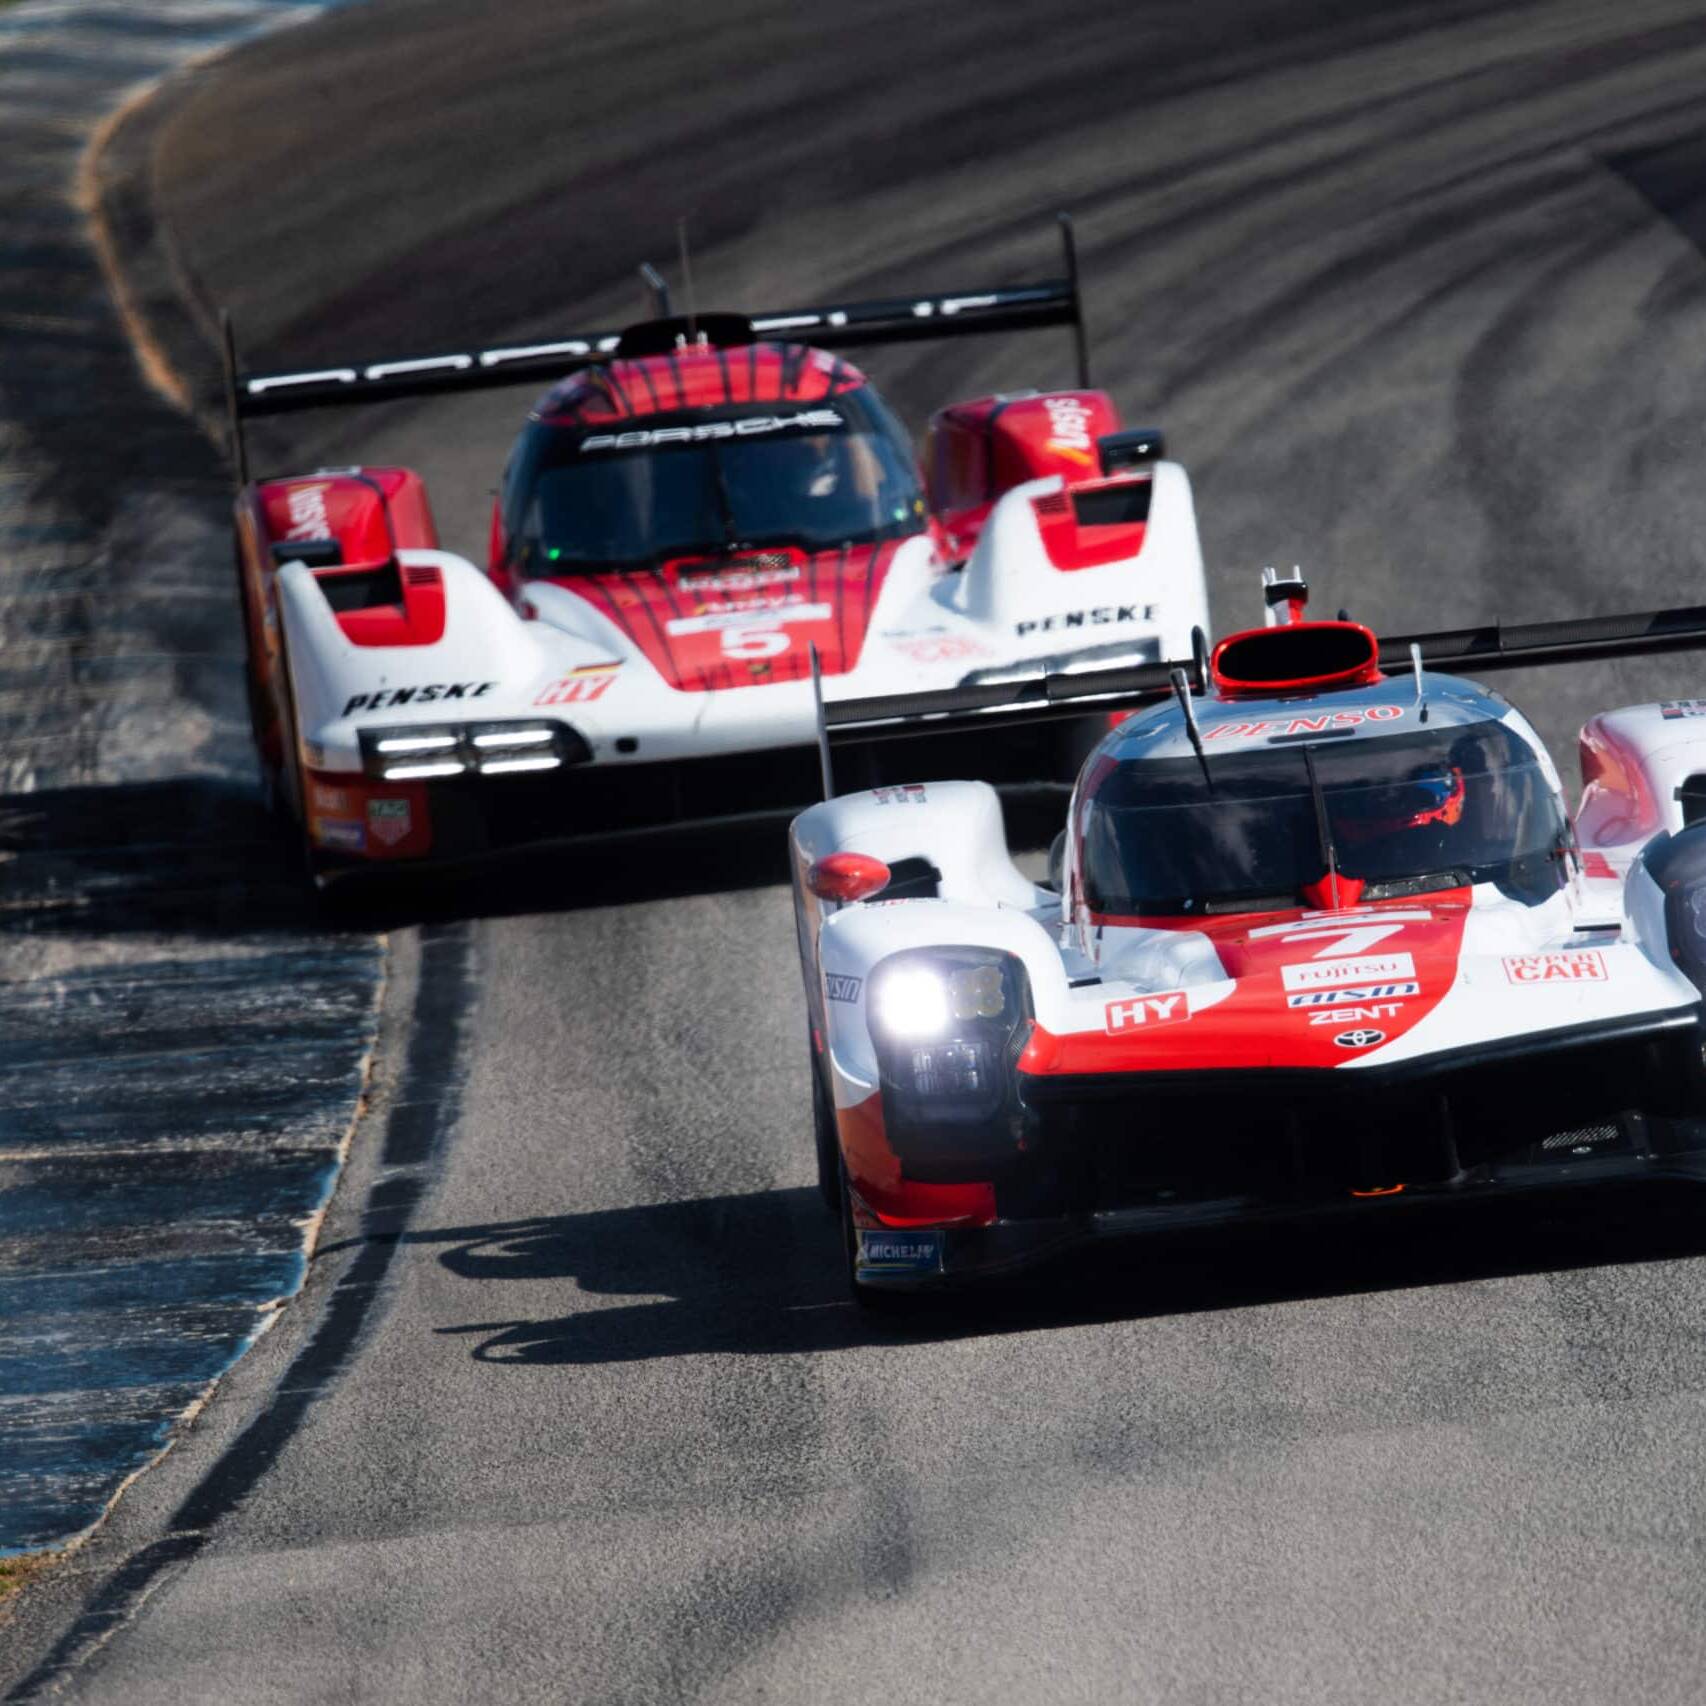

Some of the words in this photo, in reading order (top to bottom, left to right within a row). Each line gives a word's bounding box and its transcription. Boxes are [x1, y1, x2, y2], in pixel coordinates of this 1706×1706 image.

[580, 409, 845, 452] PORSCHE
[1014, 602, 1160, 637] PENSKE
[720, 619, 792, 660] 5
[341, 680, 499, 718] PENSKE
[1201, 704, 1404, 740] DENSO
[1280, 923, 1405, 959] 7
[1299, 961, 1400, 981] FUJITSU
[1514, 962, 1599, 981] CAR
[1111, 995, 1181, 1029] HY
[1307, 1002, 1404, 1026] ZENT
